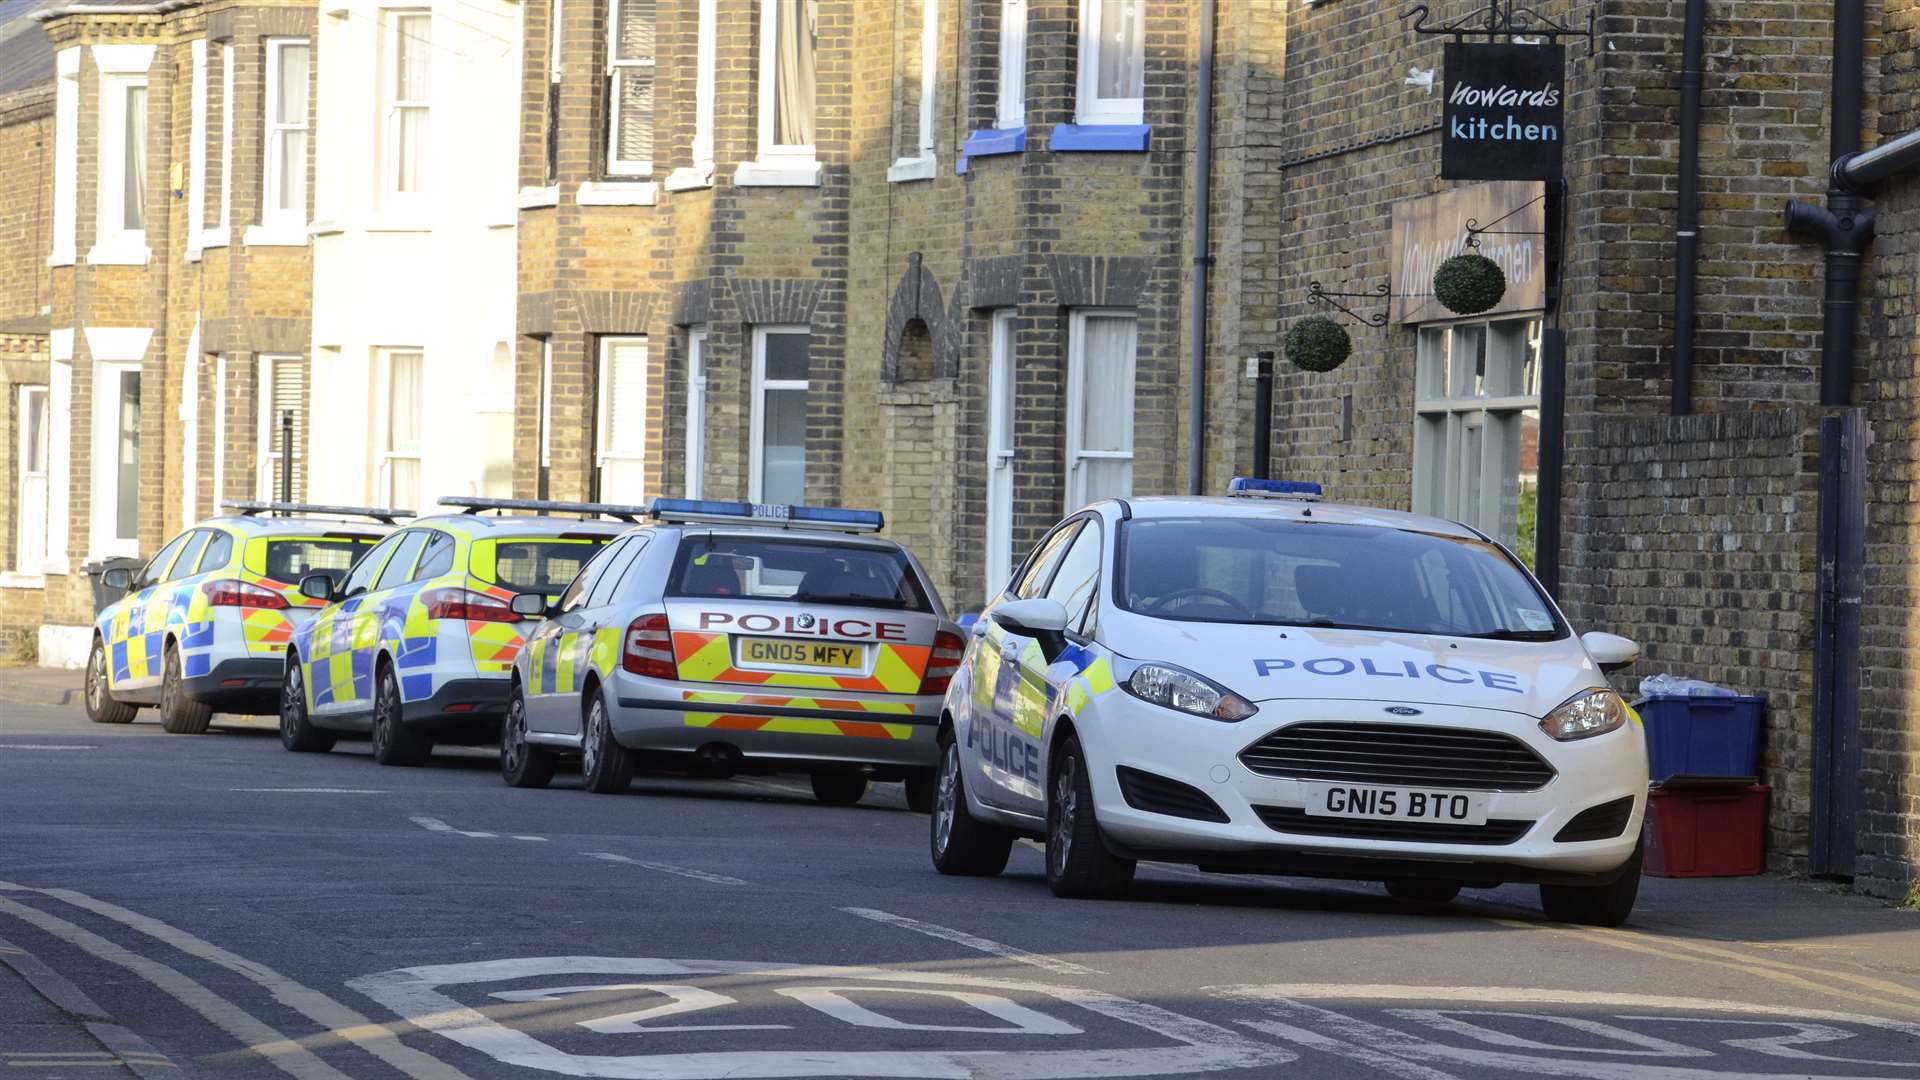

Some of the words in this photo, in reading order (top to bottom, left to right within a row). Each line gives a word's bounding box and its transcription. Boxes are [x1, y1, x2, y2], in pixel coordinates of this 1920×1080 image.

[1449, 81, 1560, 107] howards
[1451, 115, 1557, 140] kitchen
[751, 504, 788, 518] POLICE
[700, 612, 907, 642] POLICE
[751, 642, 806, 661] GN05
[813, 645, 853, 665] MFY
[1253, 657, 1524, 694] POLICE
[968, 711, 1040, 786] POLICE
[1326, 788, 1397, 816] GN15
[1407, 792, 1469, 820] BTO
[488, 983, 1086, 1034] 20
